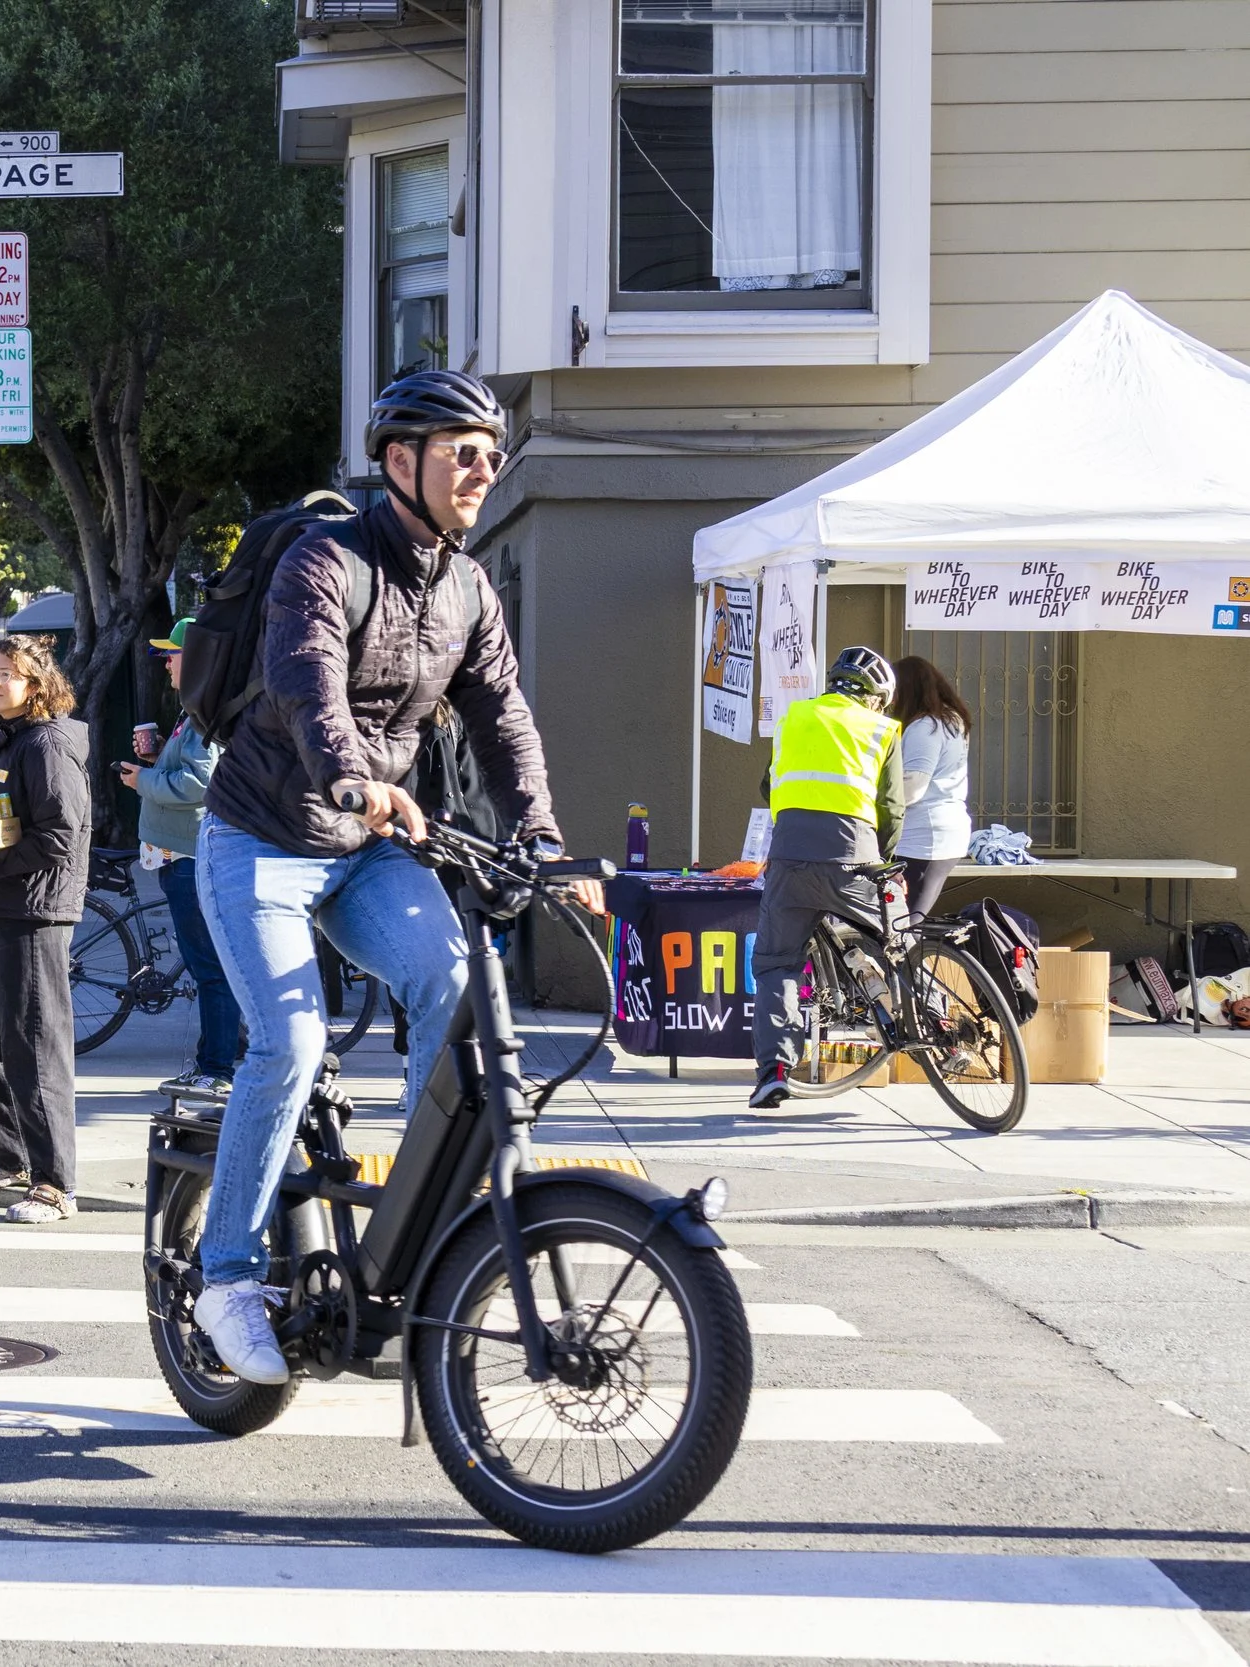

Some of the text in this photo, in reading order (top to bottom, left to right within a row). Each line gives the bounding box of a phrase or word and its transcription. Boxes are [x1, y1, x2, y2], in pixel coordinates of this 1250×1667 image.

[20, 136, 50, 150] 900
[2, 390, 21, 402] FRI
[10, 408, 24, 416] WITH
[0, 425, 27, 433] PERMITS
[928, 562, 964, 575] BIKE
[1021, 562, 1058, 576] BIKE
[1117, 562, 1155, 576] BIKE
[951, 572, 970, 588] TO
[1045, 573, 1065, 588] TO
[1140, 576, 1160, 591] TO
[914, 585, 999, 605] WHEREVER
[1008, 585, 1091, 606] WHEREVER
[1101, 589, 1189, 606] WHEREVER
[944, 601, 977, 618] DAY
[1039, 601, 1071, 618] DAY
[1131, 605, 1165, 620] DAY
[664, 1002, 733, 1032] SLOW
